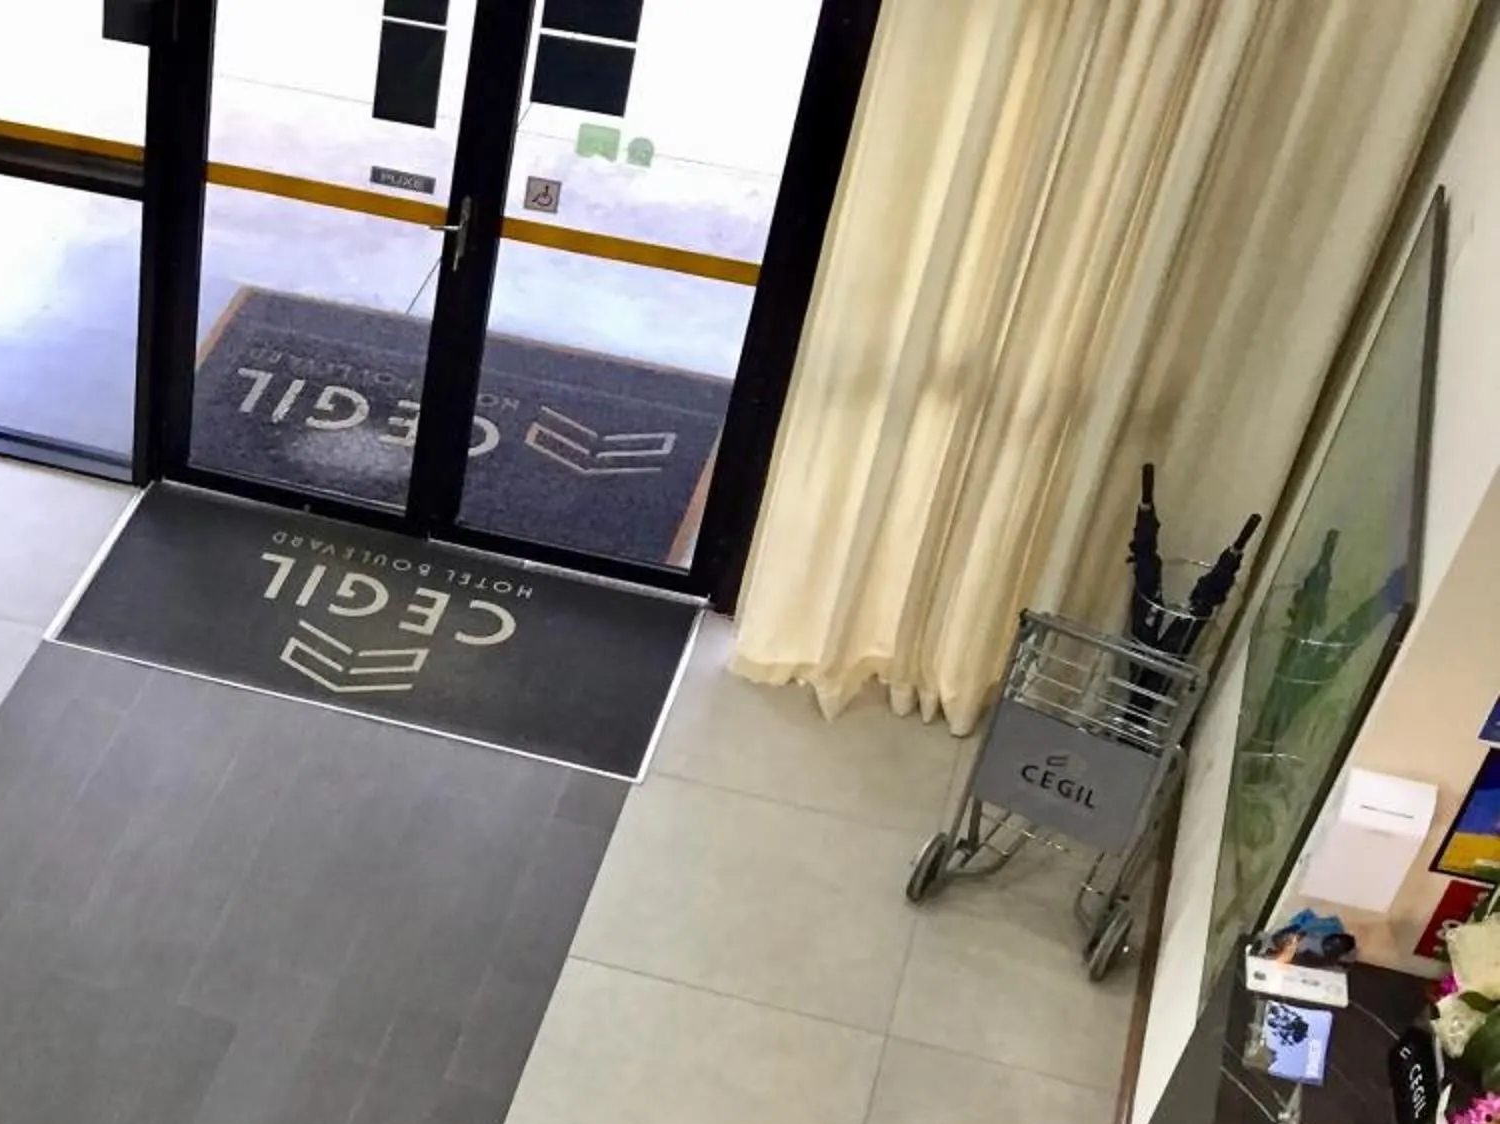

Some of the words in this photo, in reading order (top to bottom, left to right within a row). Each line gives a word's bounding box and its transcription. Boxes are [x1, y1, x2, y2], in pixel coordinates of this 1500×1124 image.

[238, 367, 500, 456] CEGIL
[272, 530, 432, 577] BOULEVARD
[260, 552, 517, 645] CEGIL
[445, 568, 533, 600] HOTEL
[1021, 764, 1096, 809] CEGIL
[1409, 1063, 1427, 1119] CEGIL
